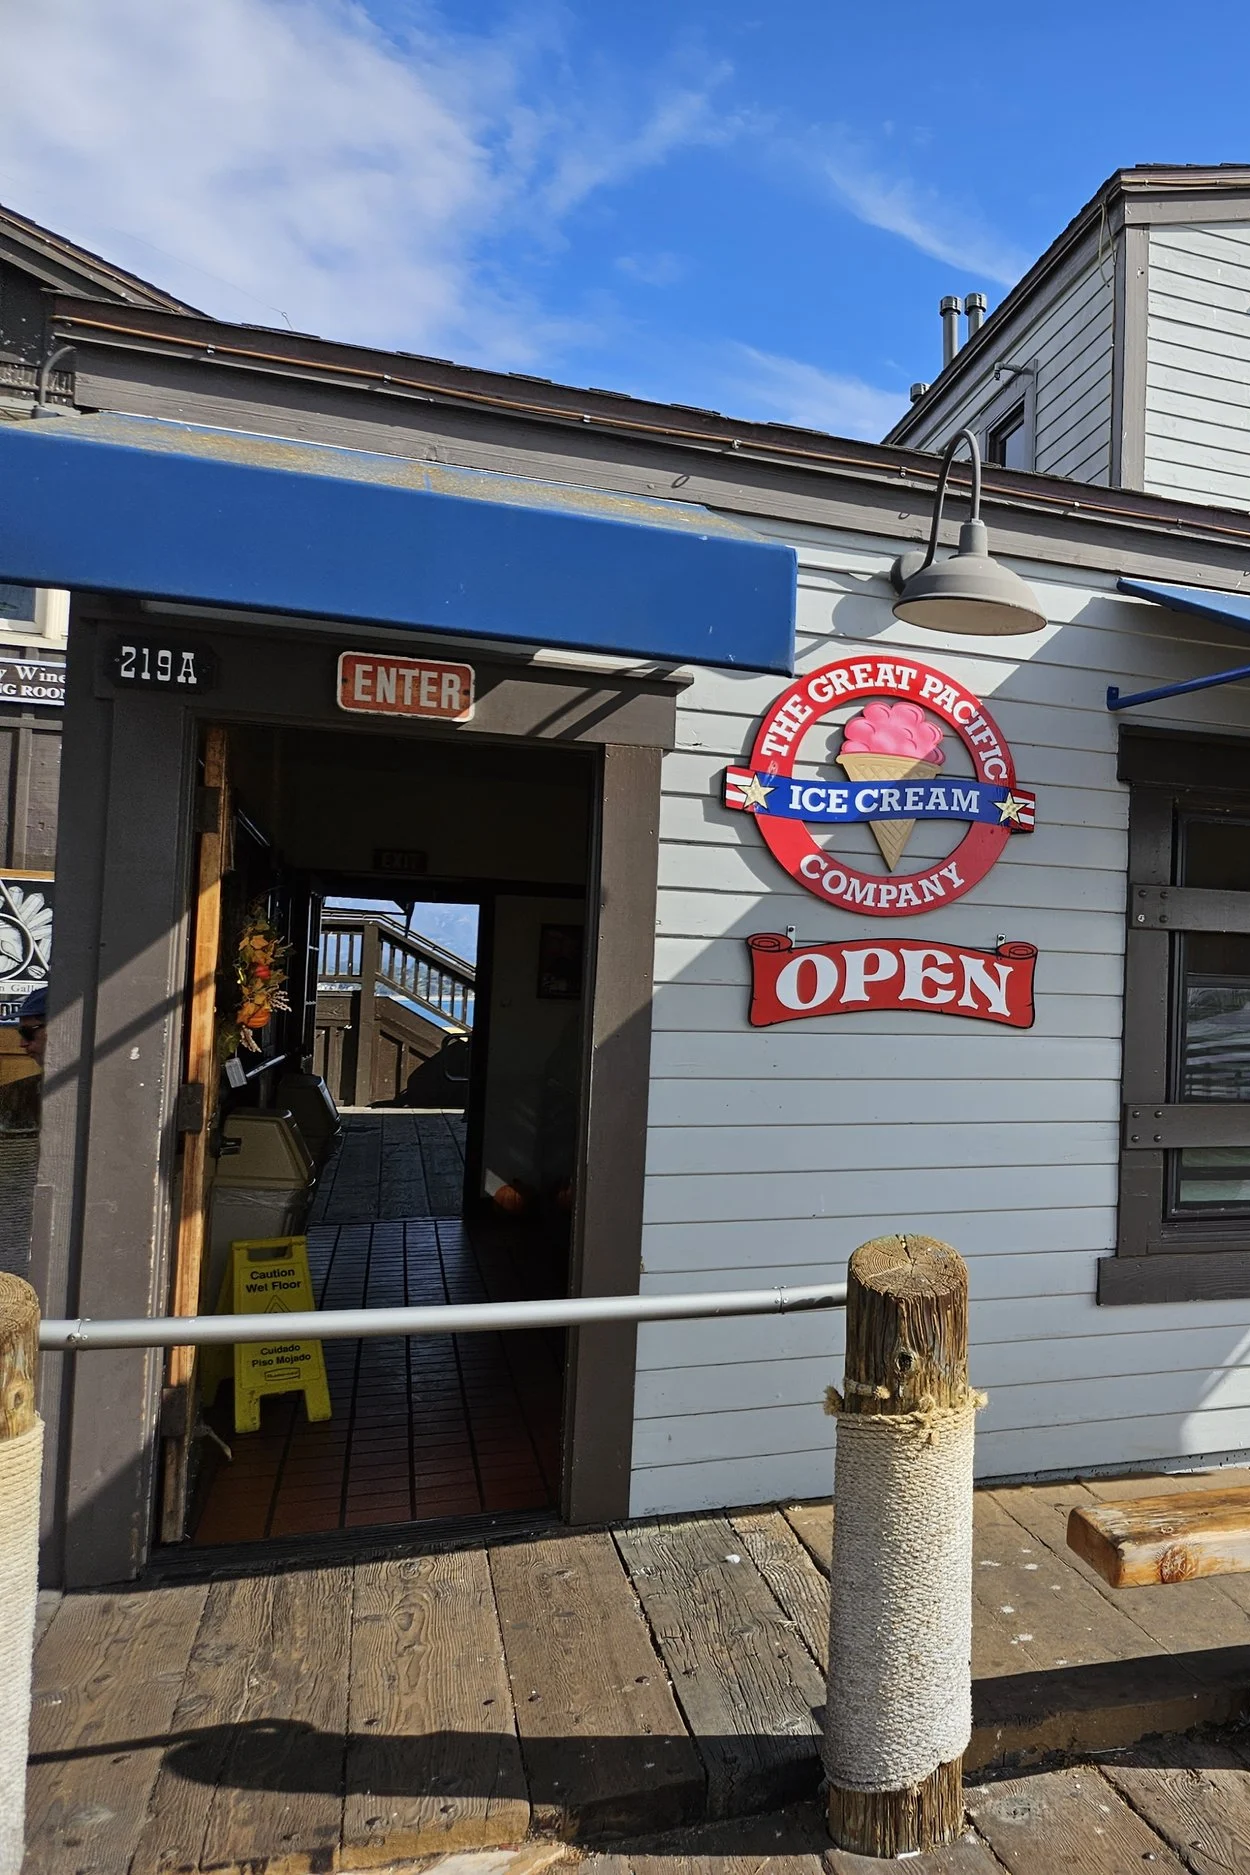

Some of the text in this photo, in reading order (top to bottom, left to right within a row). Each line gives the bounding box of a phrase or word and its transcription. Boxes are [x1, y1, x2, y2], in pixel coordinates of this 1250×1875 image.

[120, 646, 198, 684] 219A
[354, 663, 462, 711] ENTER
[761, 664, 1008, 782] THE GREAT PACIFIC
[788, 784, 980, 814] ICE CREAM
[382, 851, 422, 868] EXIT
[800, 853, 967, 909] COMPANY
[775, 947, 1015, 1017] OPEN
[246, 1281, 301, 1293] Wet Floor
[250, 1268, 295, 1280] Caution
[251, 1353, 312, 1368] Piso Mojado
[260, 1344, 301, 1356] Cuidado
